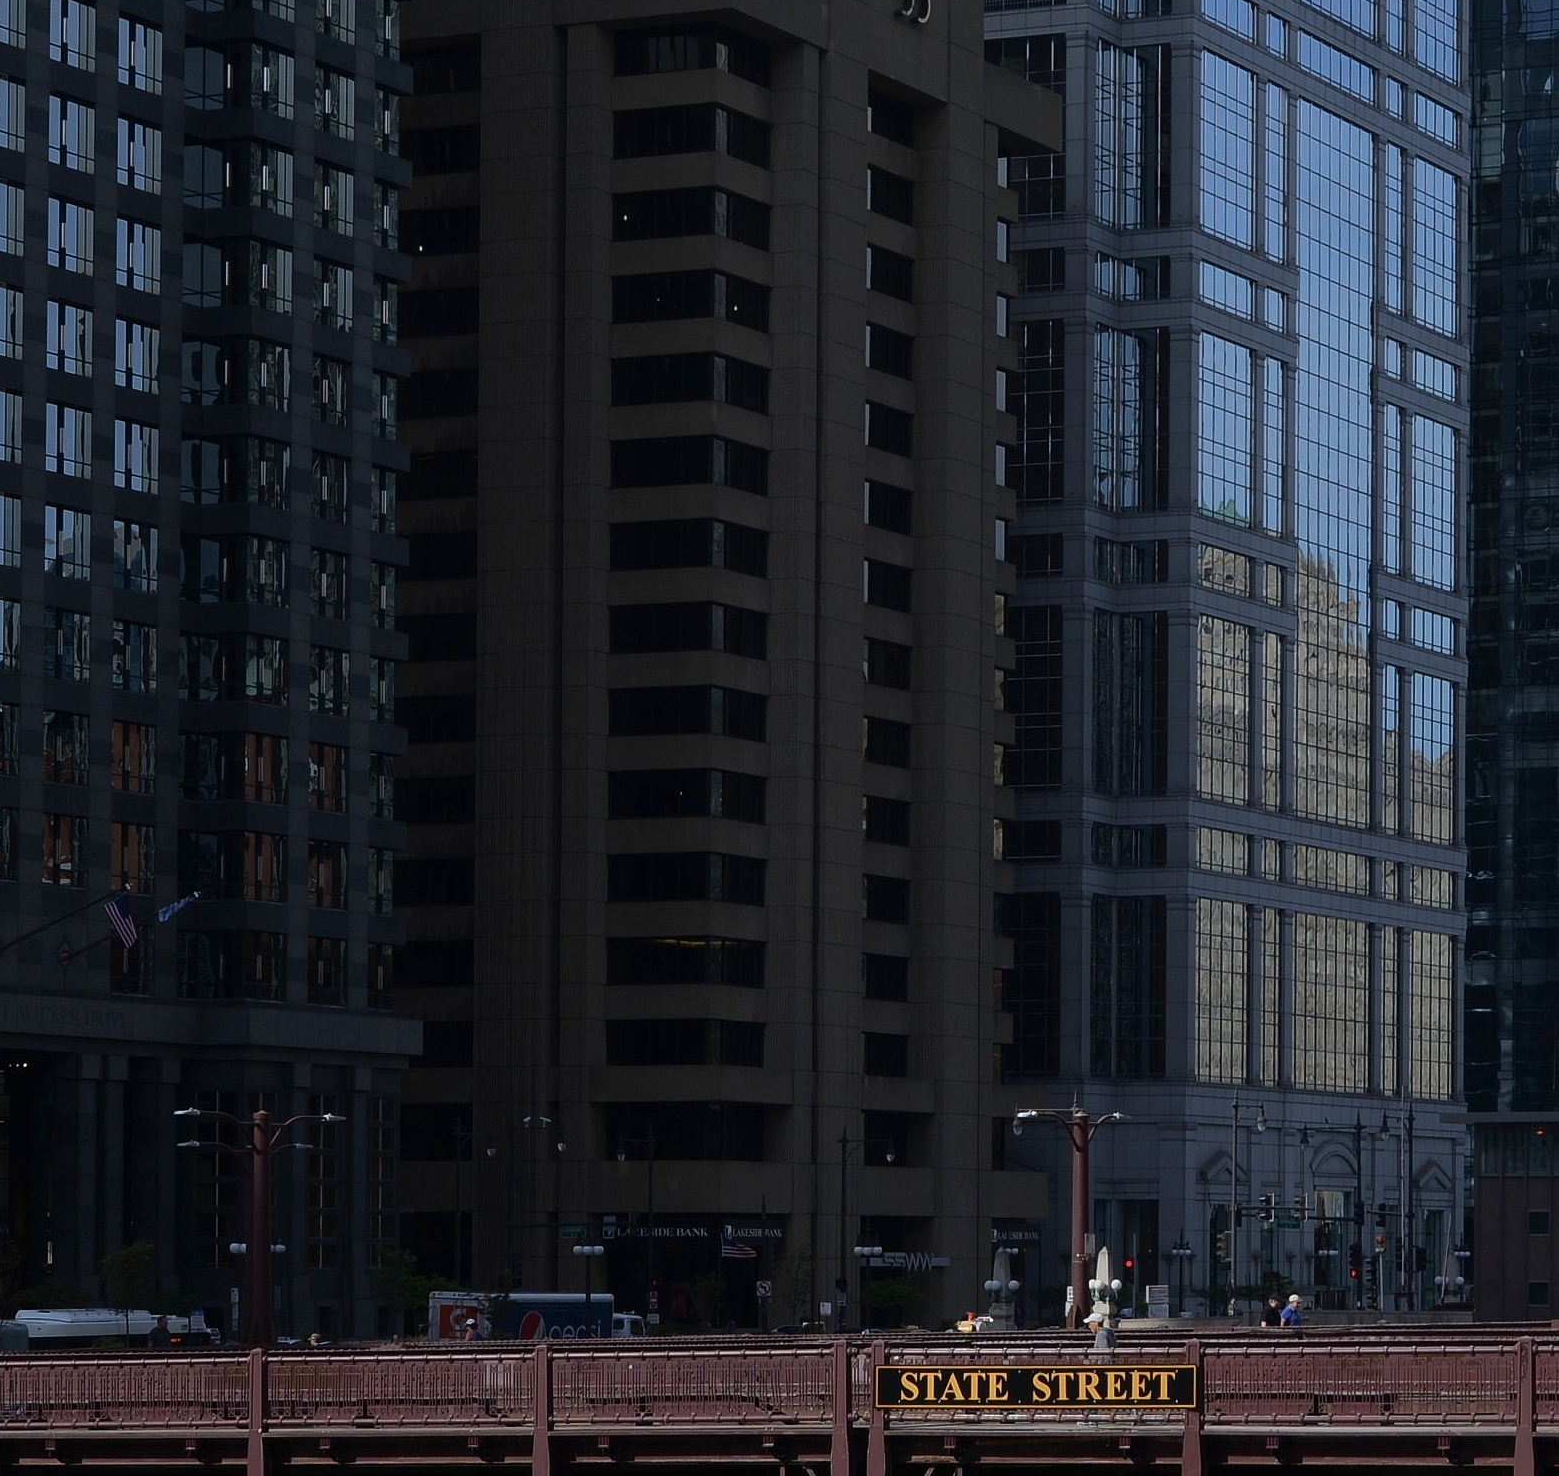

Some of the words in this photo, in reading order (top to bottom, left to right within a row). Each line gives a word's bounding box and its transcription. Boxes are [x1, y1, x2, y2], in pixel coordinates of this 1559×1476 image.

[18, 1004, 79, 1026] WACKER
[676, 1227, 709, 1238] BANK
[900, 1372, 1009, 1402] STATE
[1032, 1372, 1176, 1402] STREET
